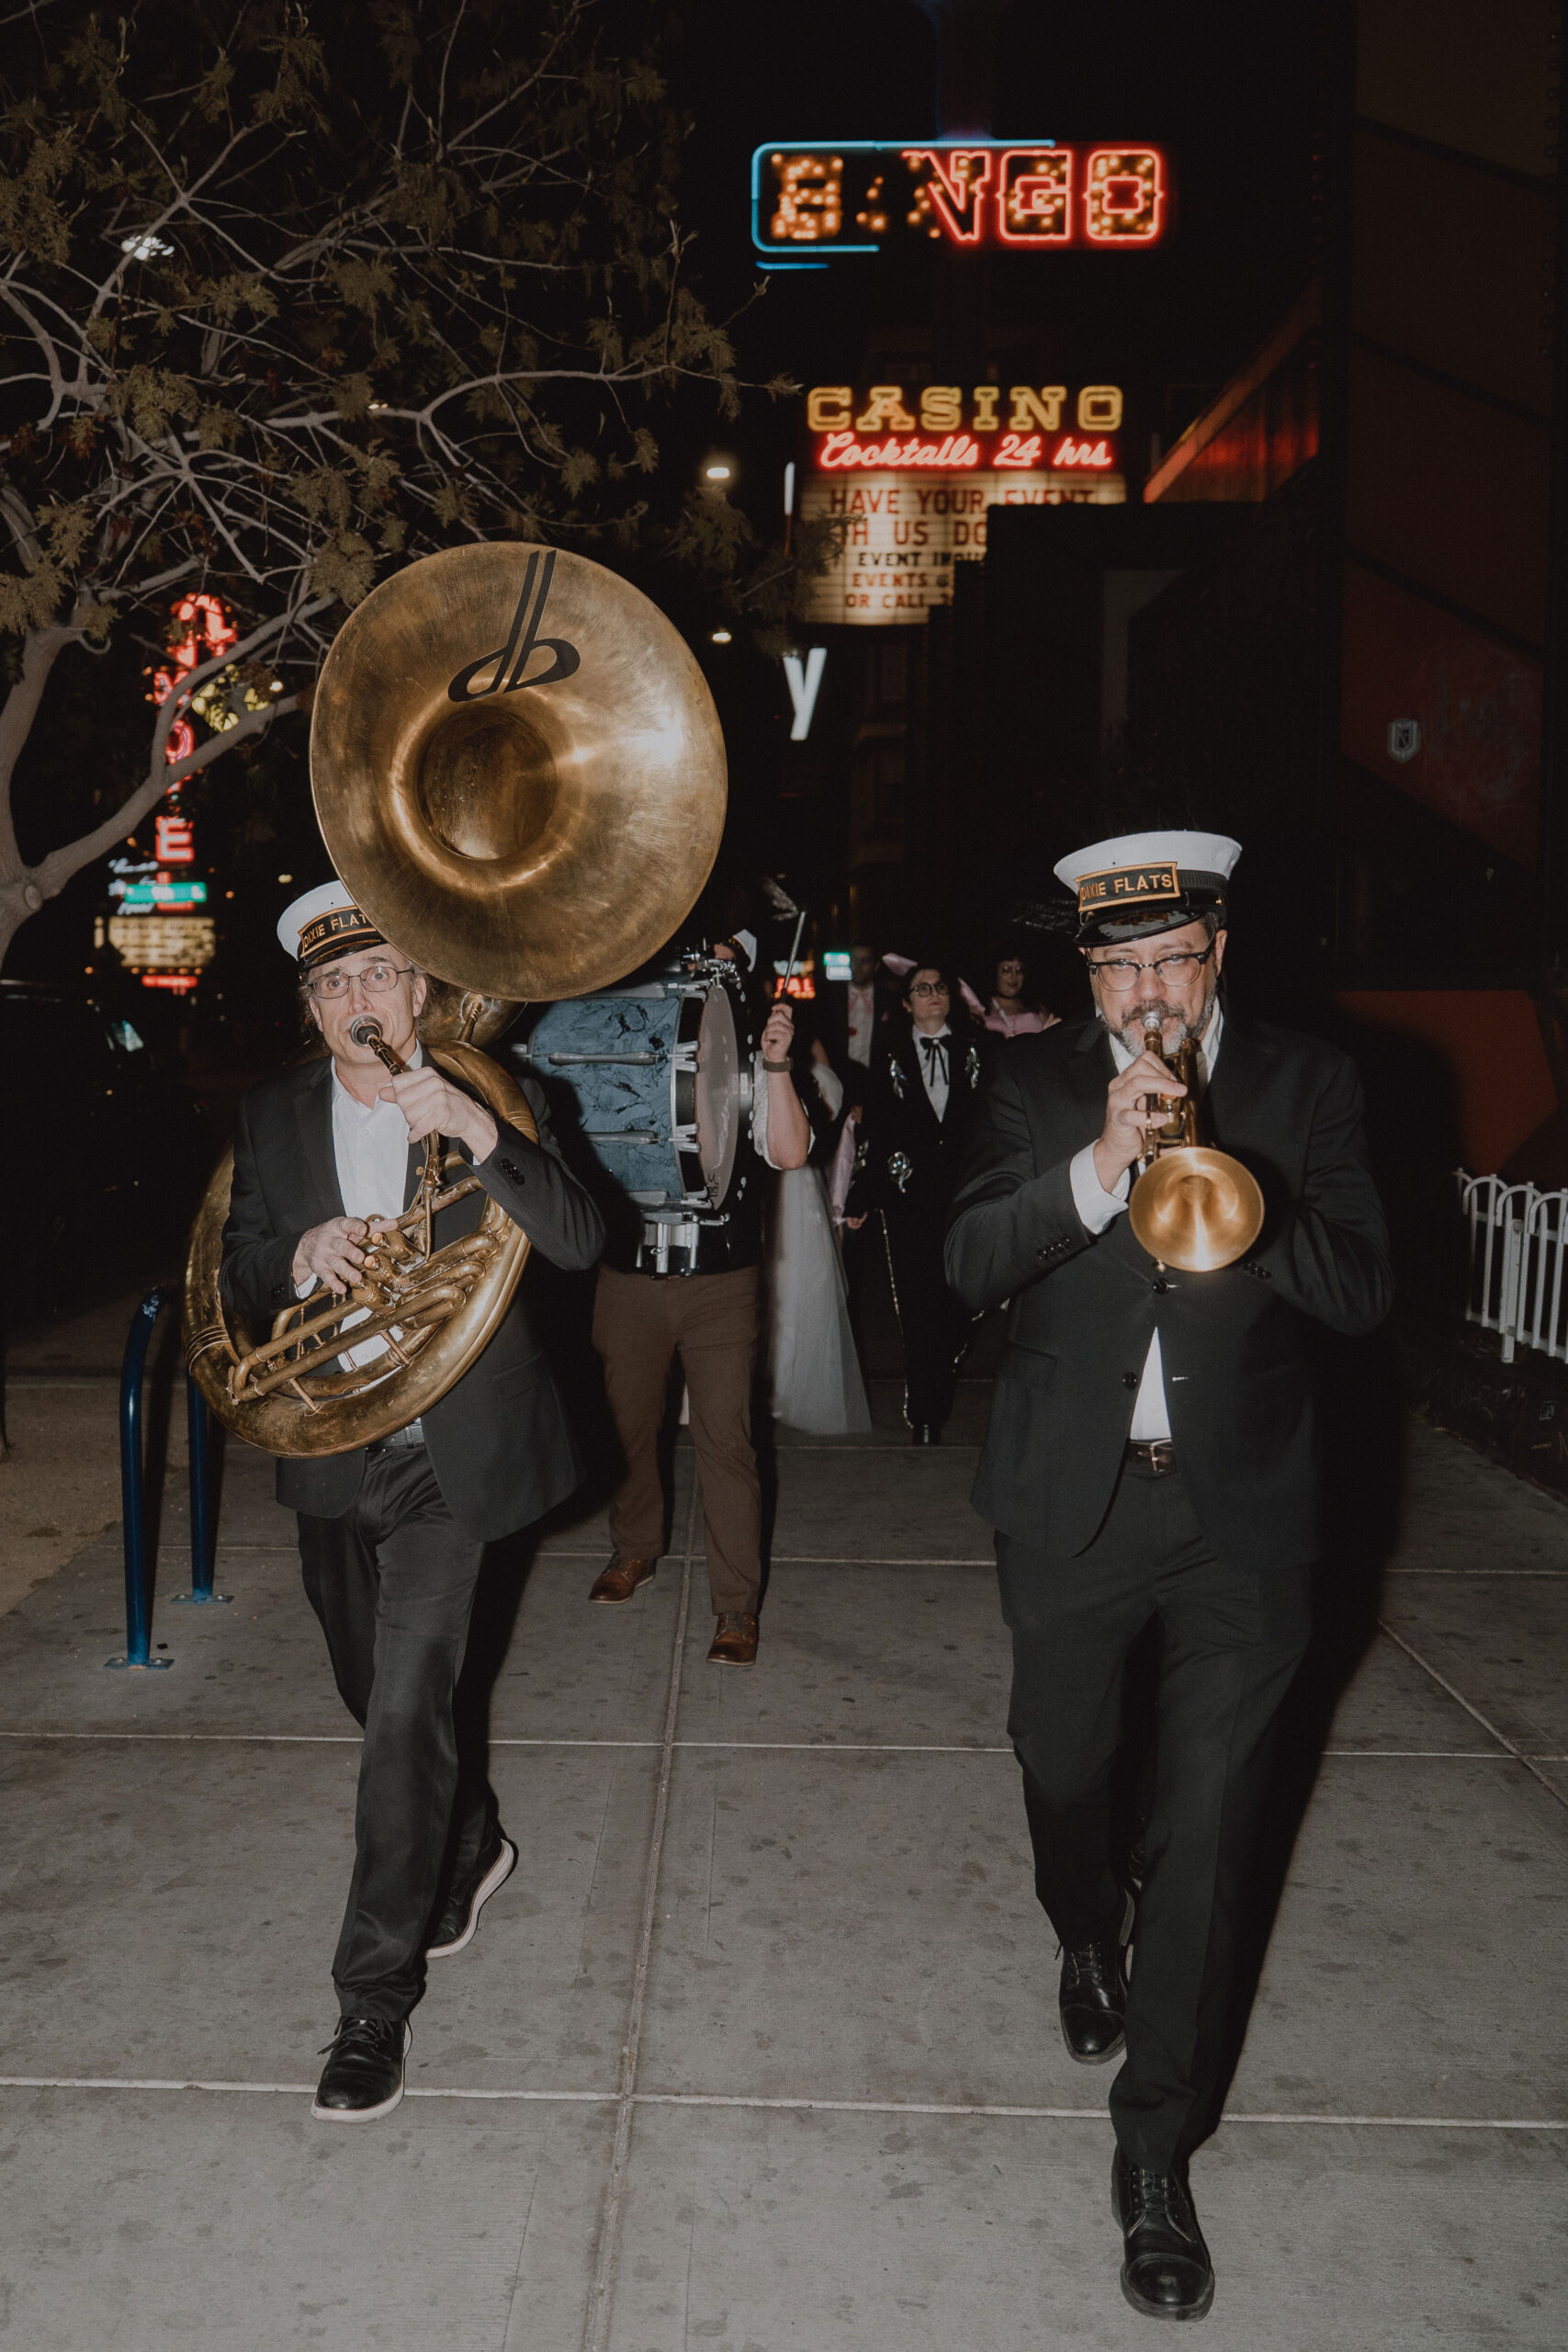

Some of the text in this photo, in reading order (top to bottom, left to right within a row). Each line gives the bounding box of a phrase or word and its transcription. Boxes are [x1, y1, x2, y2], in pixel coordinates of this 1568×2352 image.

[807, 385, 1123, 432] CASINO
[992, 434, 1041, 467] 24
[1052, 436, 1113, 467] hrs
[829, 489, 900, 514] HAVE
[917, 489, 986, 514] YOUR
[894, 521, 928, 546] US
[858, 552, 920, 567] EVENT
[852, 572, 928, 587] EVENTS
[844, 594, 870, 608] OR
[1080, 874, 1173, 900] DIXIE FLATS
[303, 923, 326, 948] DIXIE
